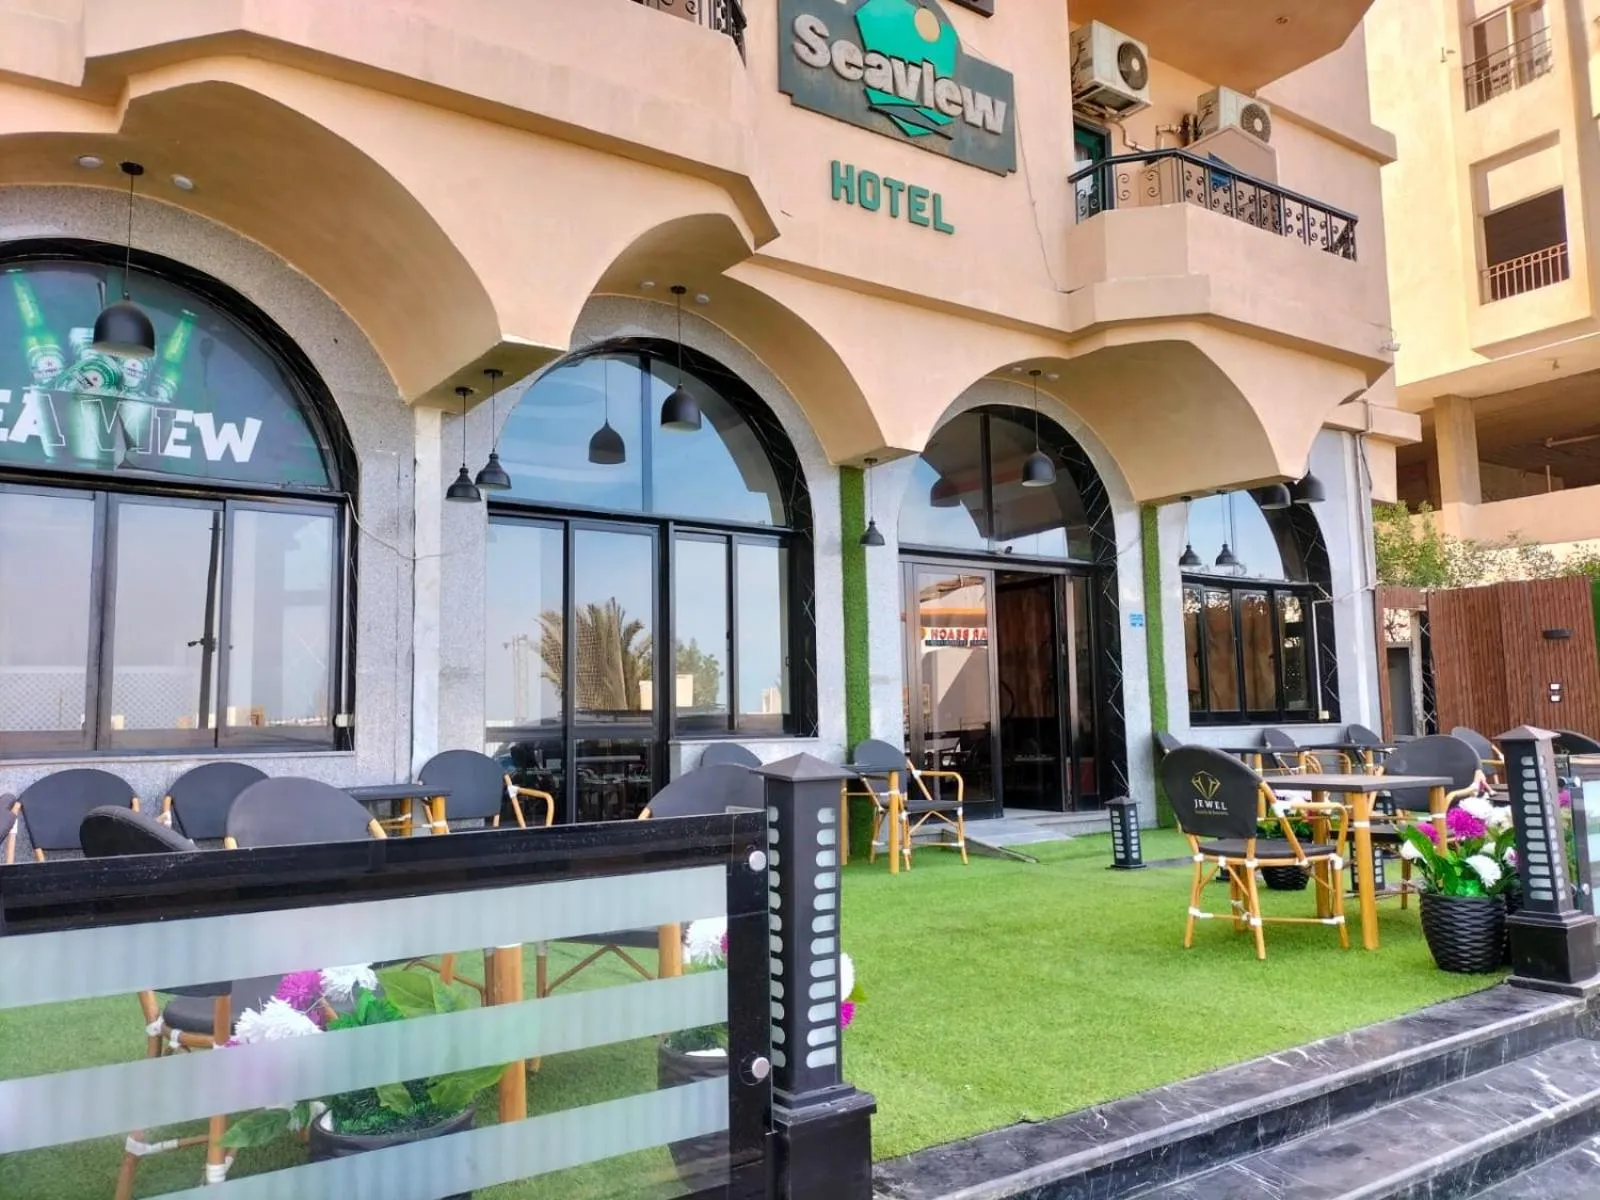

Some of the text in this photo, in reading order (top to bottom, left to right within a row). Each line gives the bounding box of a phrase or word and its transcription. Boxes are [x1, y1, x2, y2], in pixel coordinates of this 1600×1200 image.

[793, 14, 1006, 134] Seaview
[831, 160, 954, 235] HOTEL
[1194, 799, 1228, 810] JEWEL
